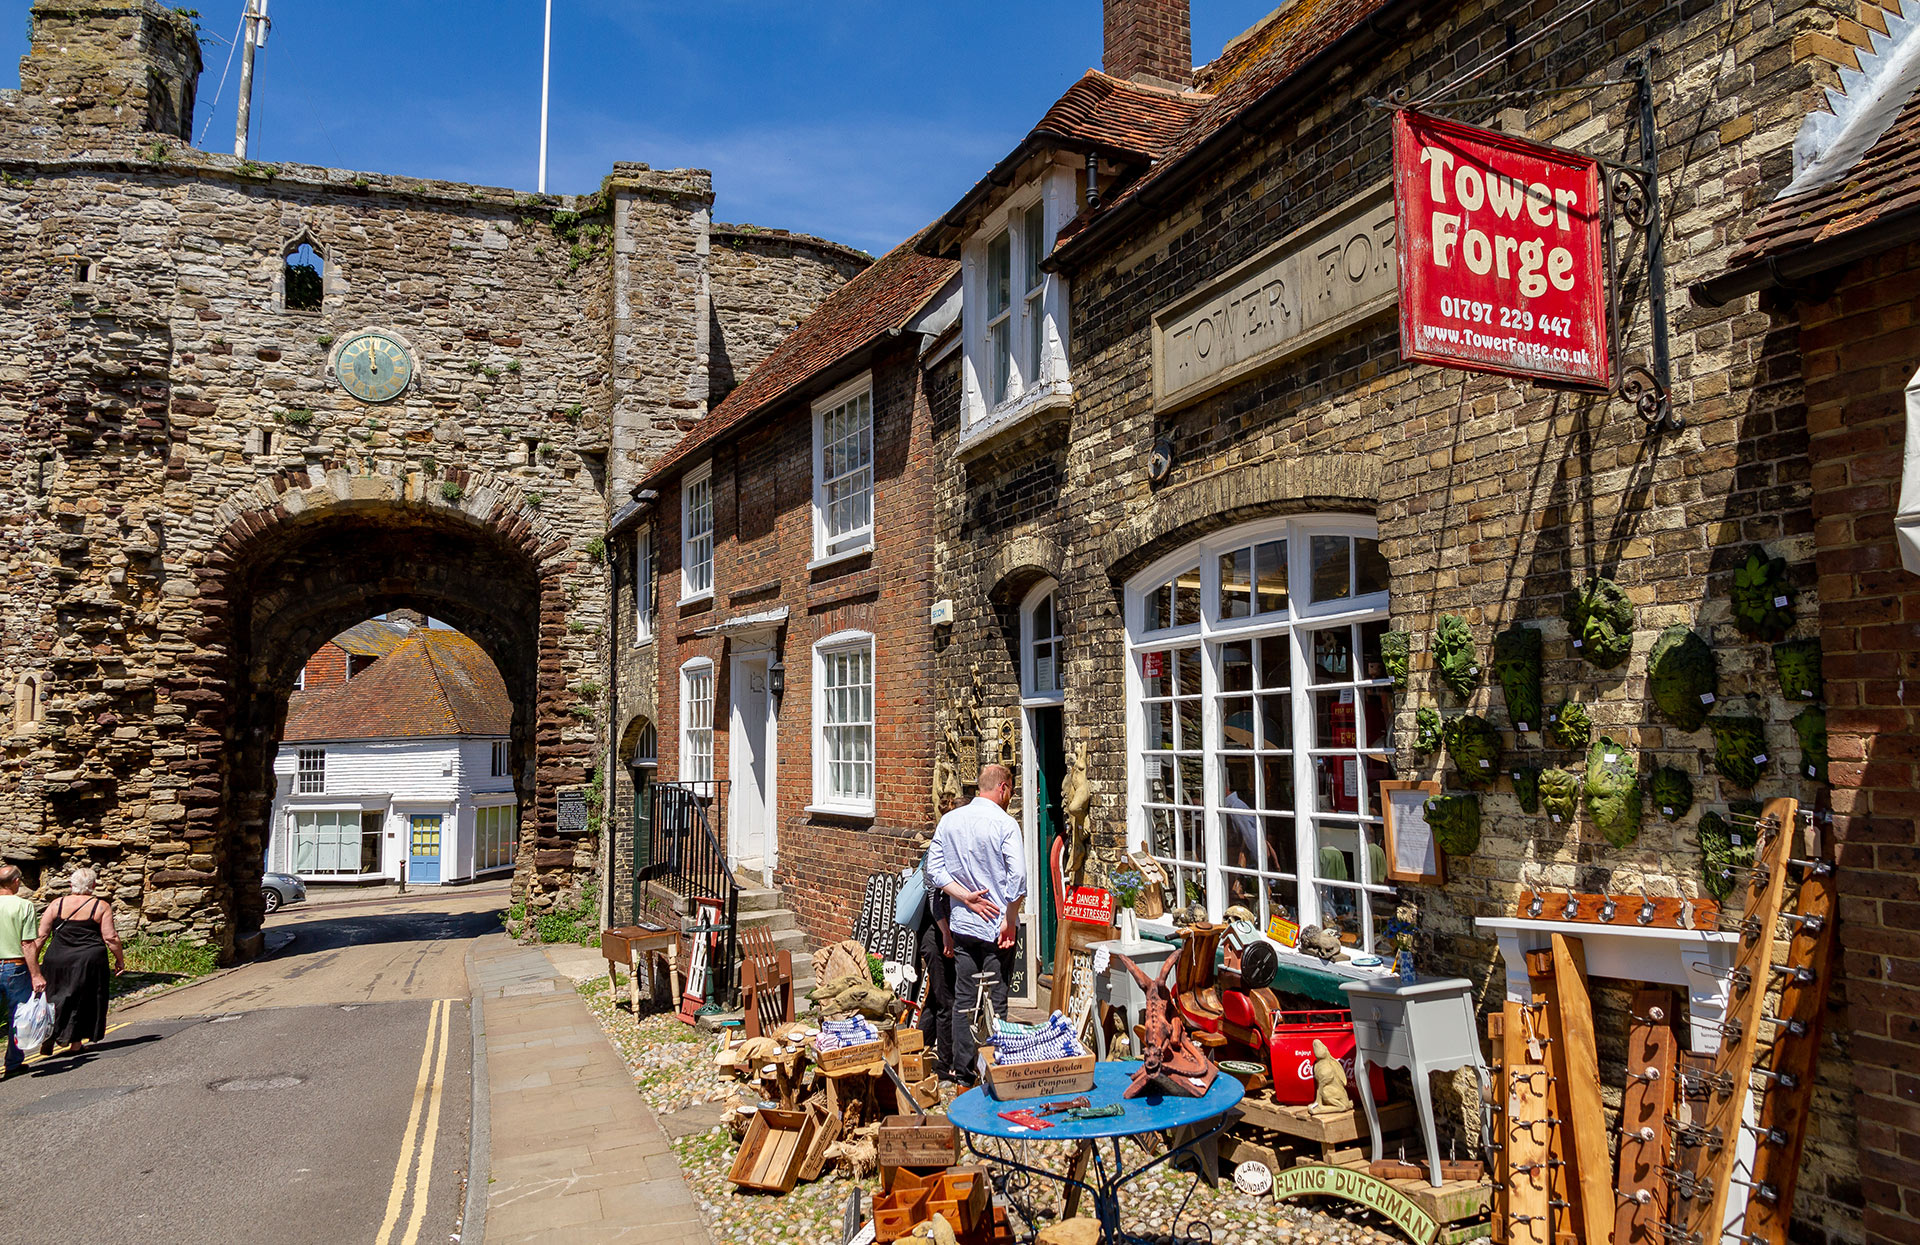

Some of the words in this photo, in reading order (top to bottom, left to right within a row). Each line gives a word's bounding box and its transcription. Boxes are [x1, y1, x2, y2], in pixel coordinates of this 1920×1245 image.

[1420, 146, 1578, 231] Tower
[1432, 211, 1575, 298] Forge
[1172, 278, 1291, 369] TOWER
[1440, 295, 1493, 325] 01797
[1500, 306, 1534, 332] 229
[1538, 314, 1571, 339] 447
[1423, 325, 1590, 366] www.TowerForge.co.uk
[1076, 893, 1100, 906] DANGER
[1083, 908, 1110, 921] STRESSED
[1005, 1069, 1021, 1079] The
[1024, 1067, 1050, 1077] Covent
[1052, 1063, 1083, 1075] Garden
[1015, 1083, 1036, 1091] Fruit
[1038, 1077, 1077, 1088] Company
[1040, 1087, 1055, 1096] Ltd
[1237, 1174, 1268, 1192] BOUNDARY
[1276, 1168, 1326, 1198] FLYING
[1335, 1172, 1427, 1240] DUTCHMAN
